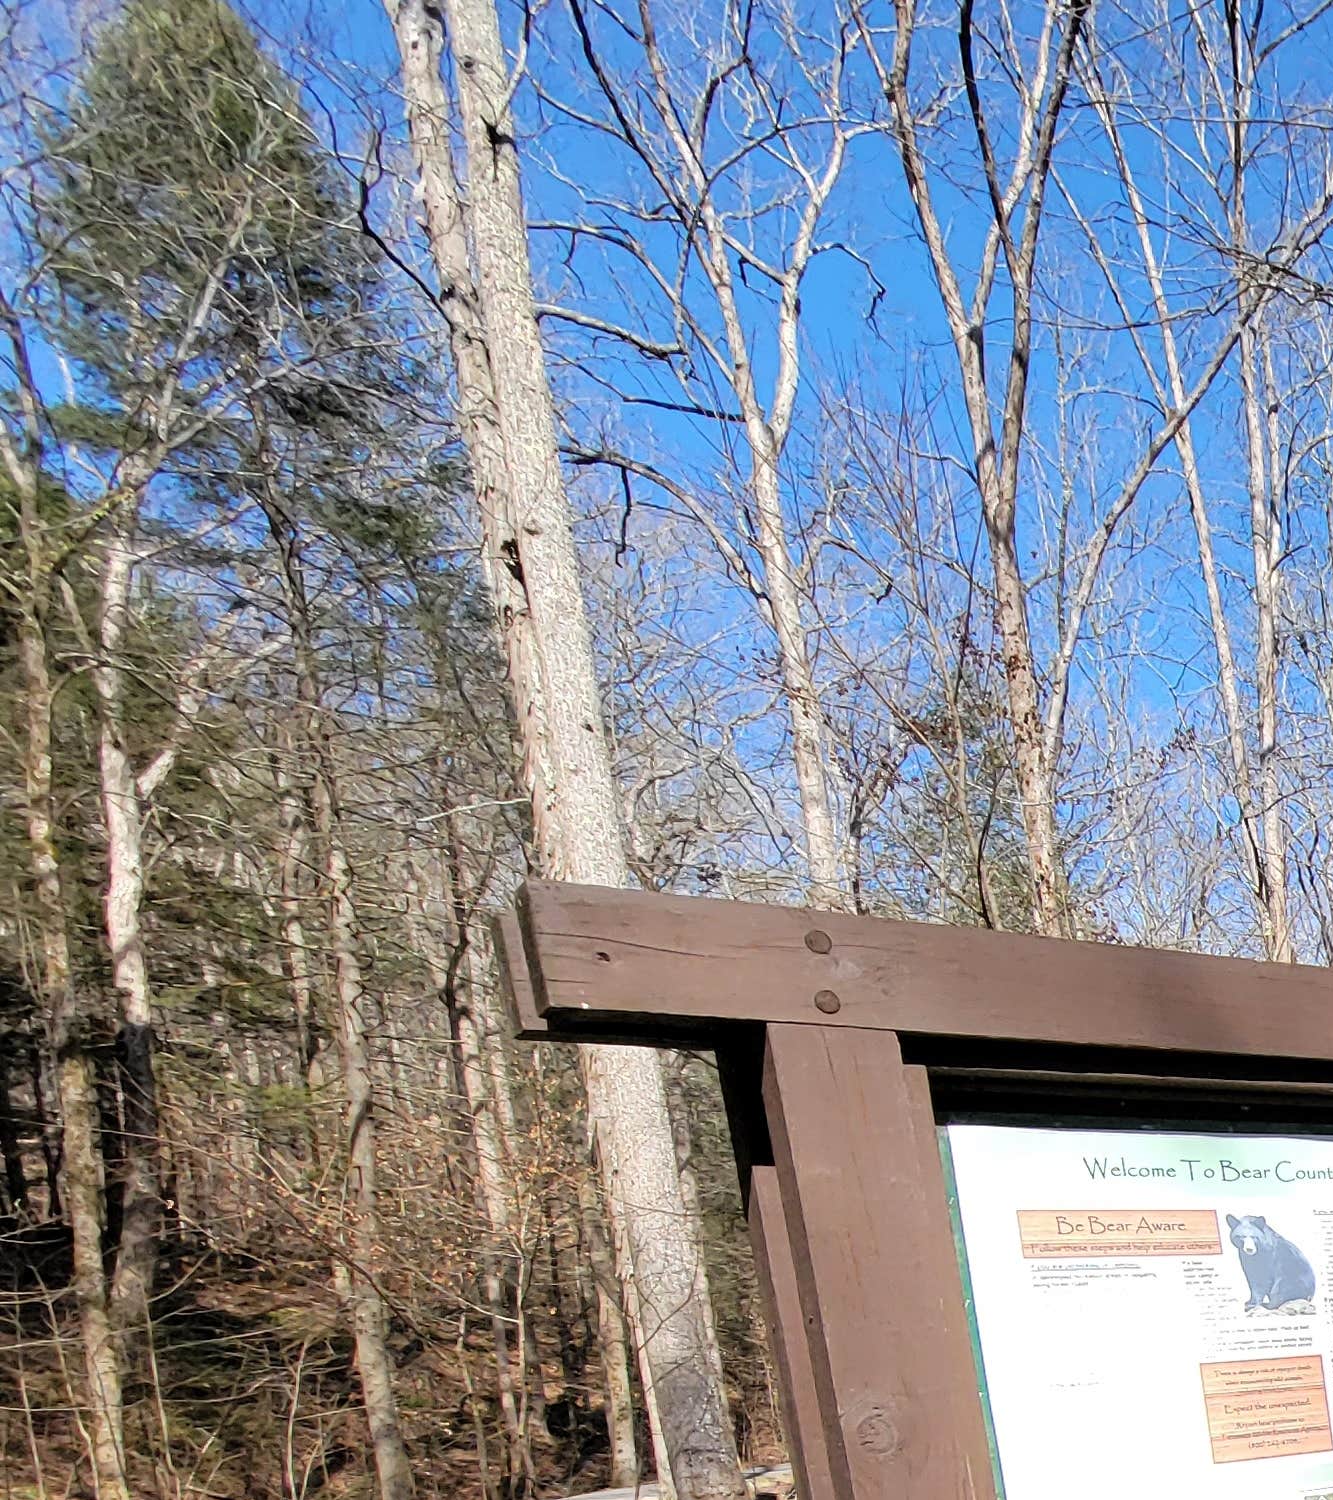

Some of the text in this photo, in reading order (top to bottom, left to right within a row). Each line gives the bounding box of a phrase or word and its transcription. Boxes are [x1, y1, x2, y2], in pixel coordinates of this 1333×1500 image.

[1083, 1157, 1177, 1180] Welcome
[1180, 1159, 1215, 1181] To
[1219, 1160, 1270, 1182] Bear
[1056, 1216, 1186, 1235] Be Bear Aware
